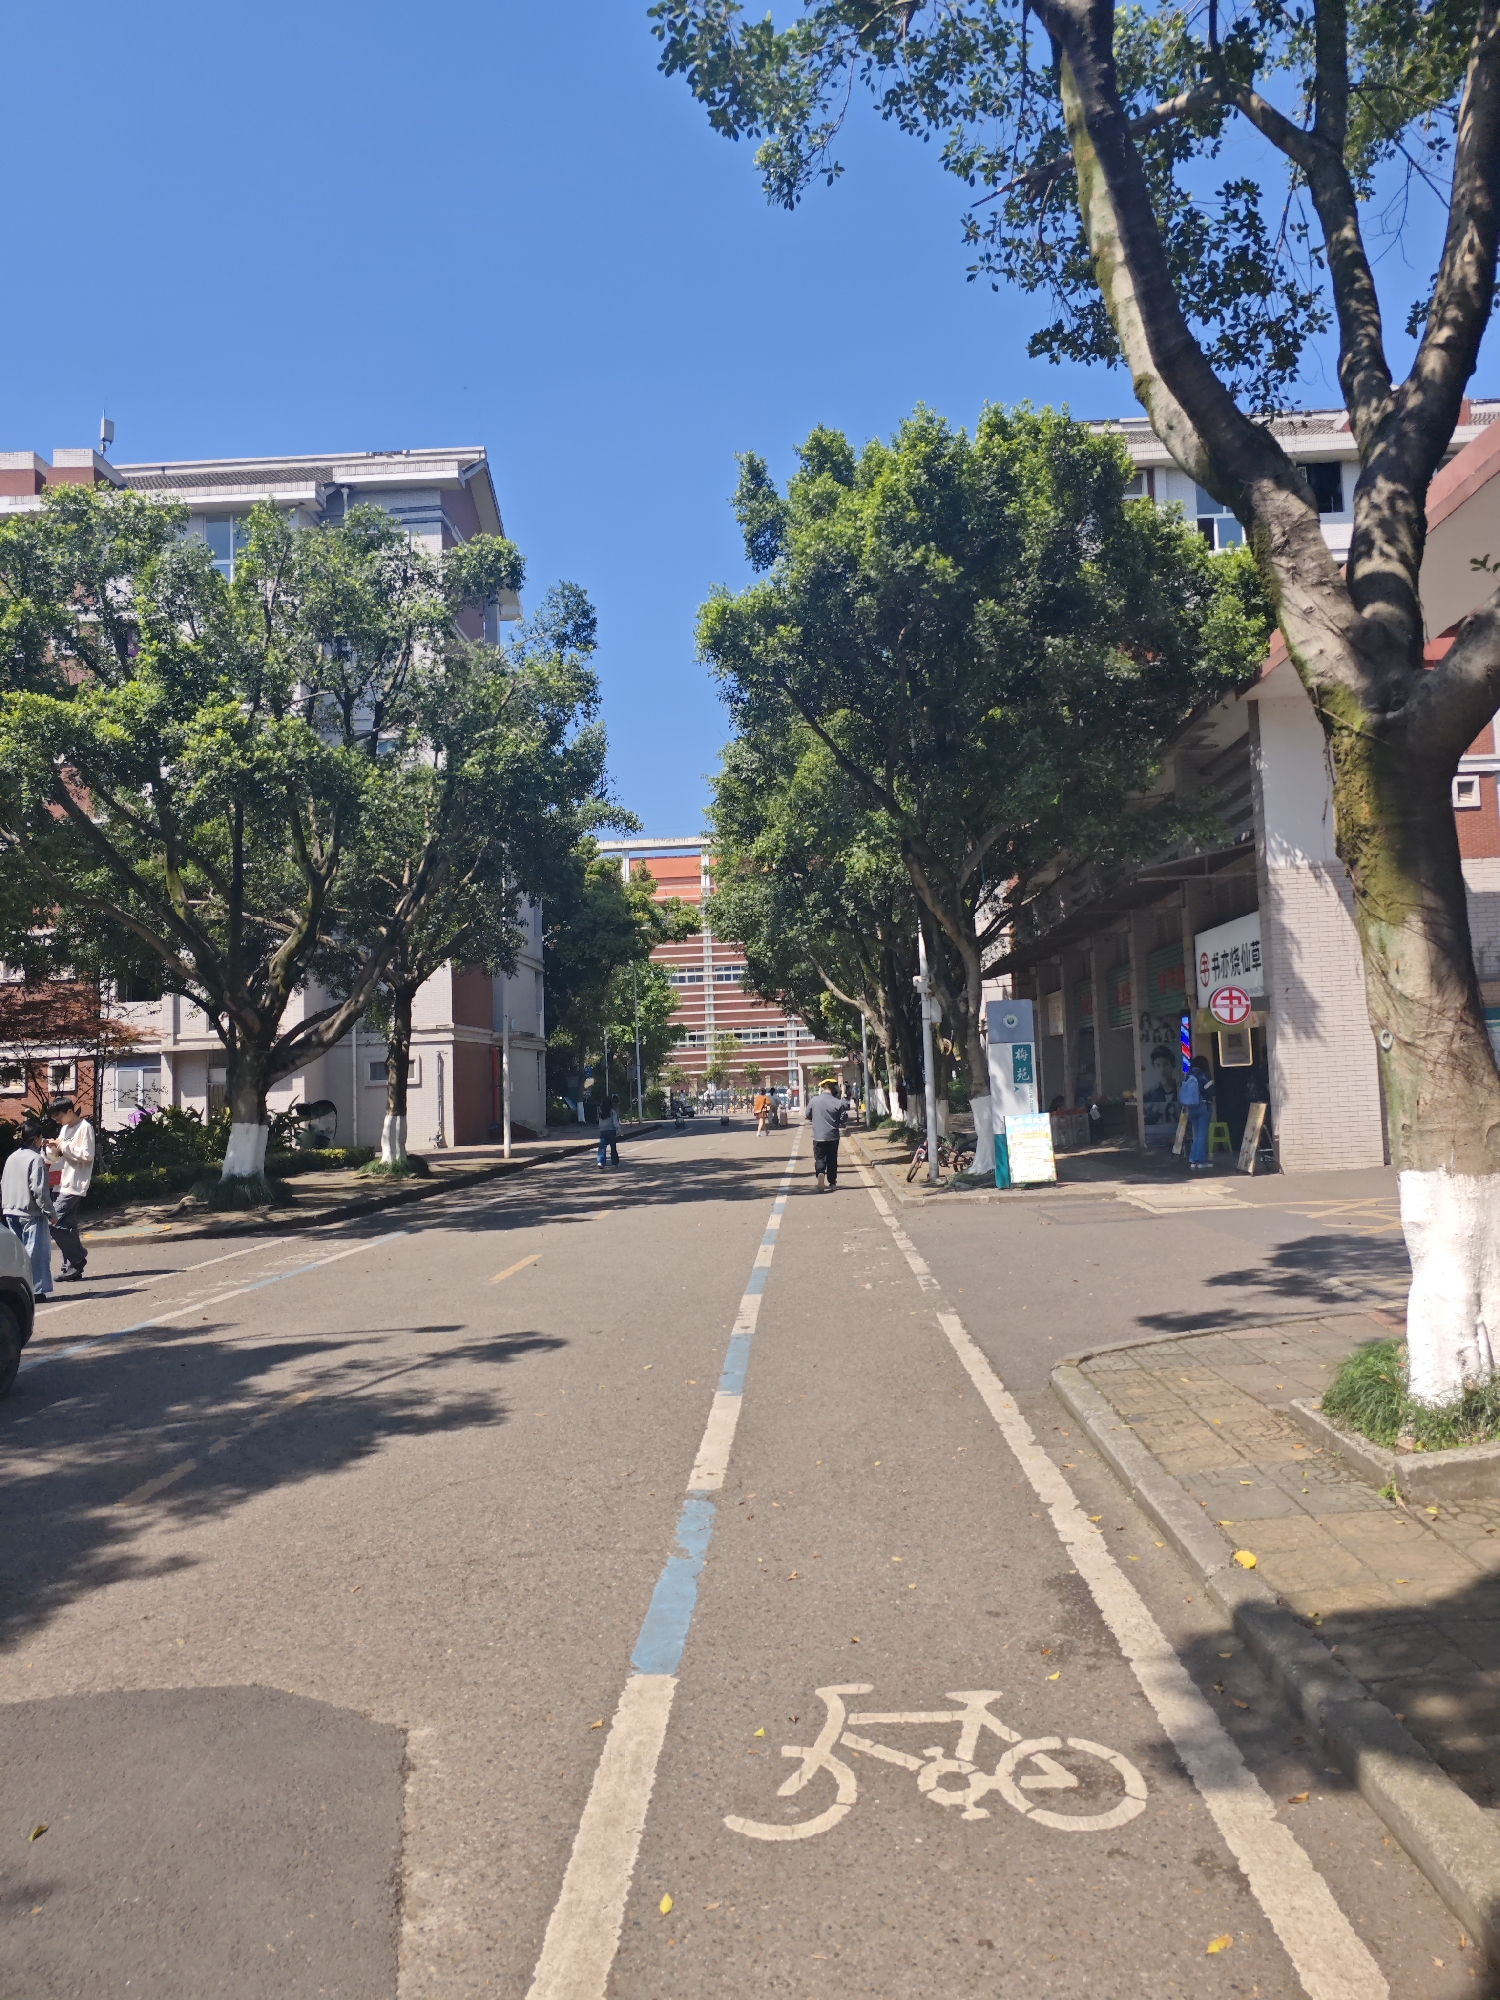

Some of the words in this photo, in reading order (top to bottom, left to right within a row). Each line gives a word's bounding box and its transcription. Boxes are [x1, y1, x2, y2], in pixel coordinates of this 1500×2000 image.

[1211, 939, 1261, 982] 书亦烧仙草
[1014, 1046, 1030, 1082] 梅苑
